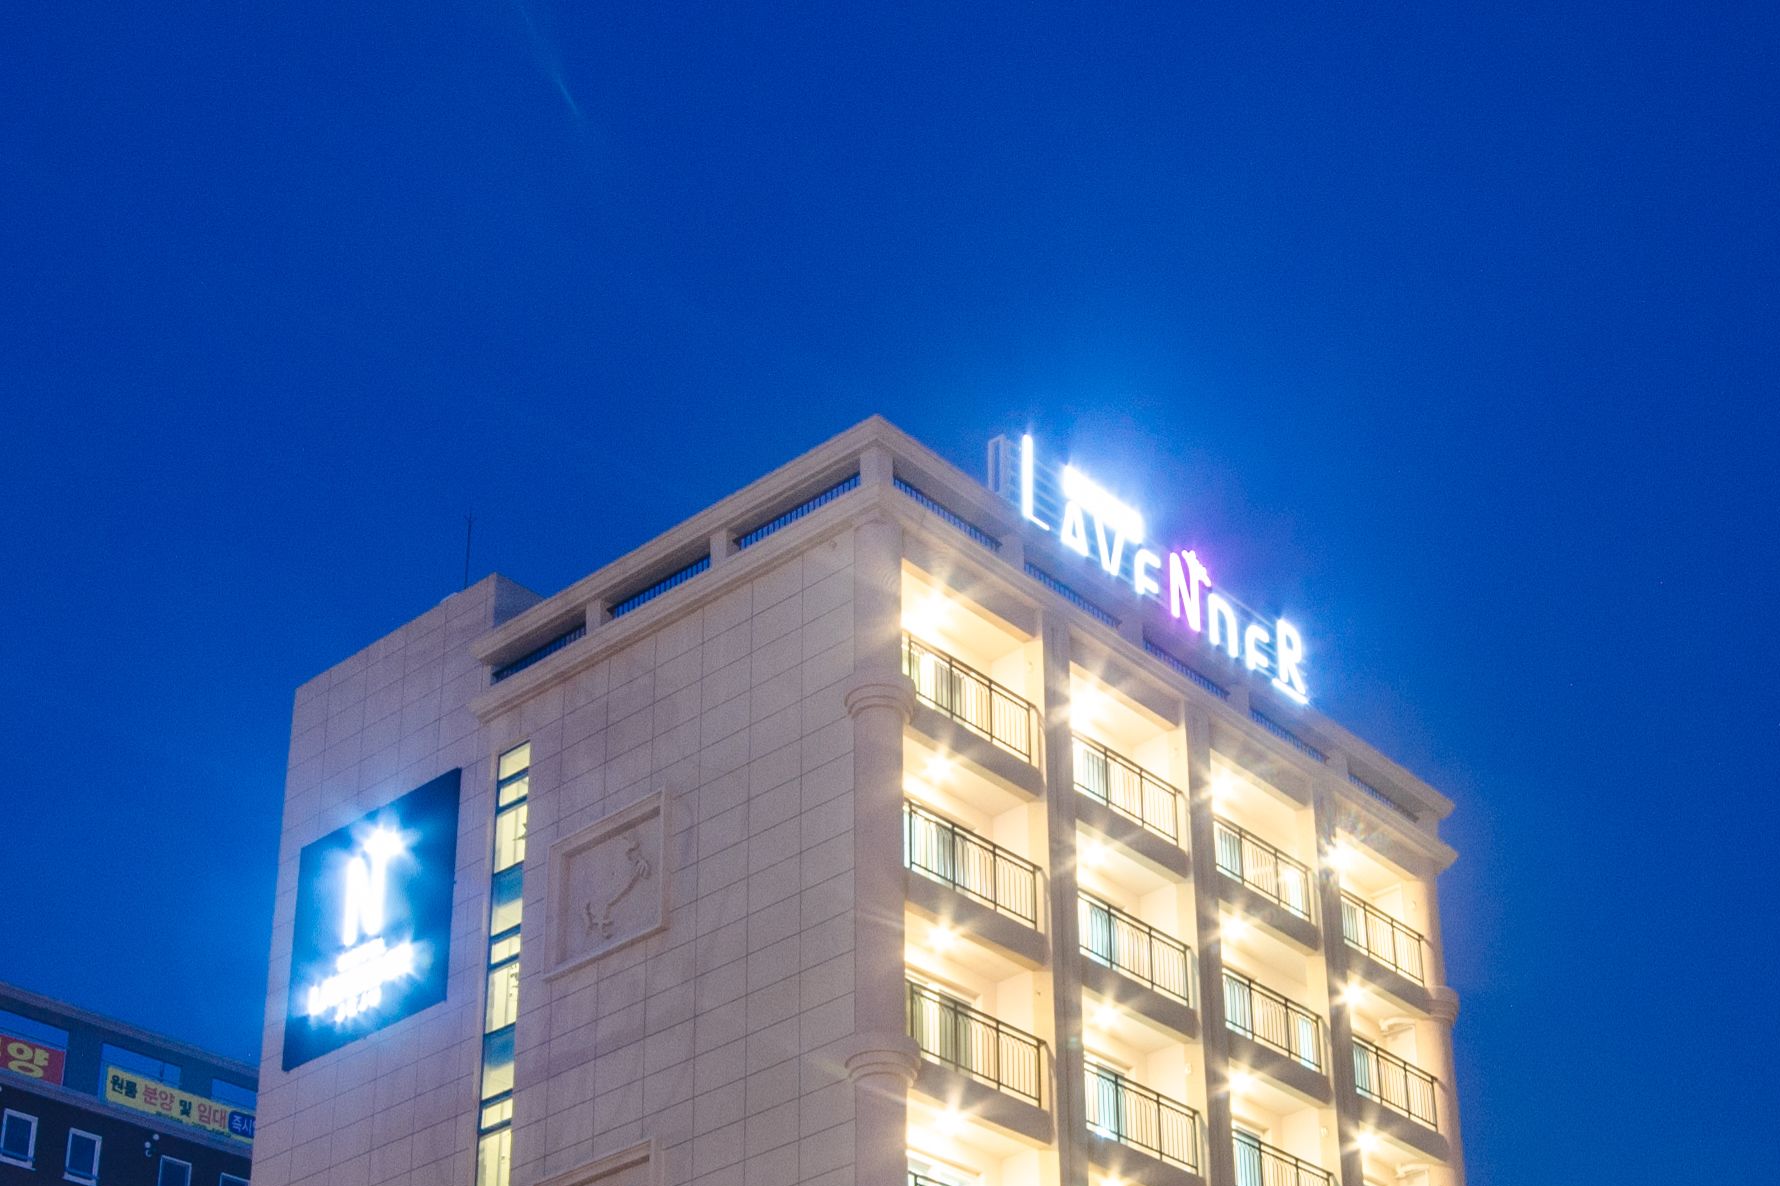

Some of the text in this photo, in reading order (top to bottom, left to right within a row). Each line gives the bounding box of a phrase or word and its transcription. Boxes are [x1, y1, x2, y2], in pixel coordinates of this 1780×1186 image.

[0, 1037, 49, 1078] 양
[111, 1075, 137, 1099] 원룸
[143, 1084, 175, 1111] 분양
[180, 1100, 192, 1117] 및
[197, 1102, 227, 1129] 임대
[232, 1115, 256, 1136] 즉시
